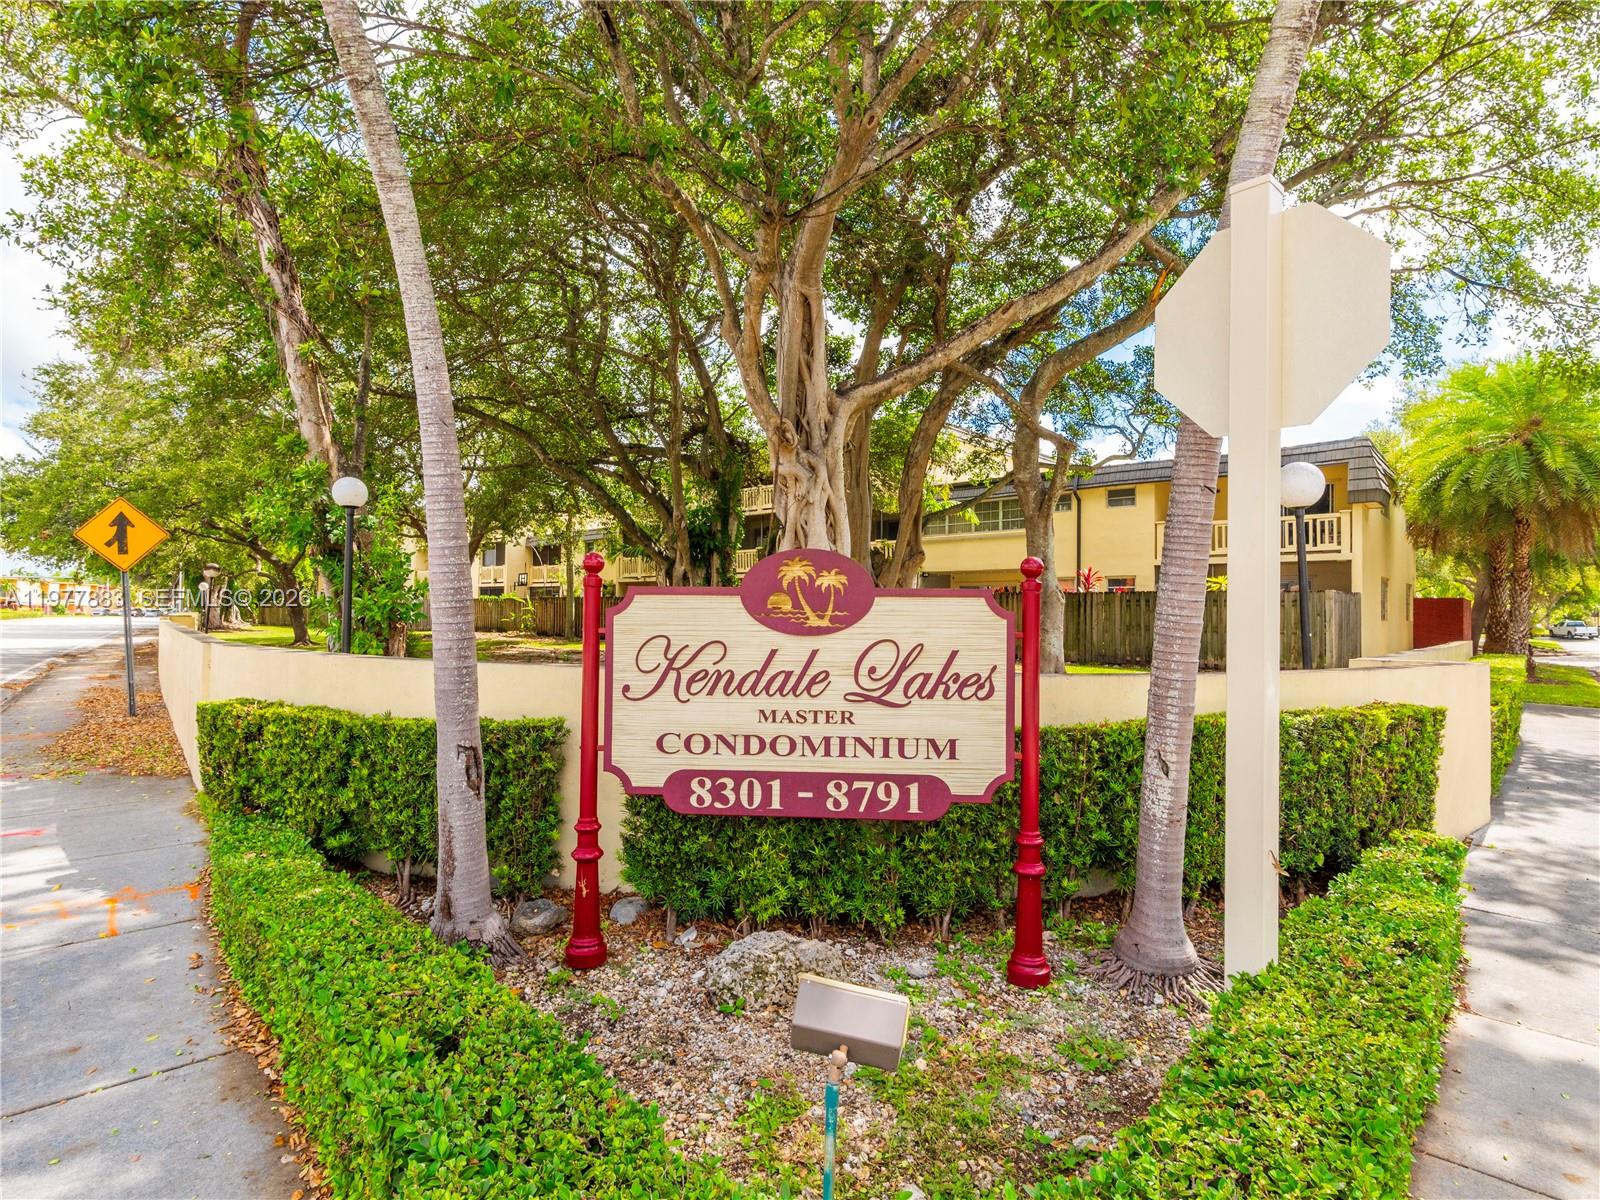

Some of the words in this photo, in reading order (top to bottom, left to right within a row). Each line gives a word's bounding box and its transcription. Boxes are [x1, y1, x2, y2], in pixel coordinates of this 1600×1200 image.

[622, 635, 830, 704] Kendale
[844, 638, 997, 708] Lakes
[757, 709, 855, 725] MASTER
[656, 732, 960, 760] CONDOMINIUM
[689, 776, 784, 811] 8301
[825, 781, 921, 814] 8791
